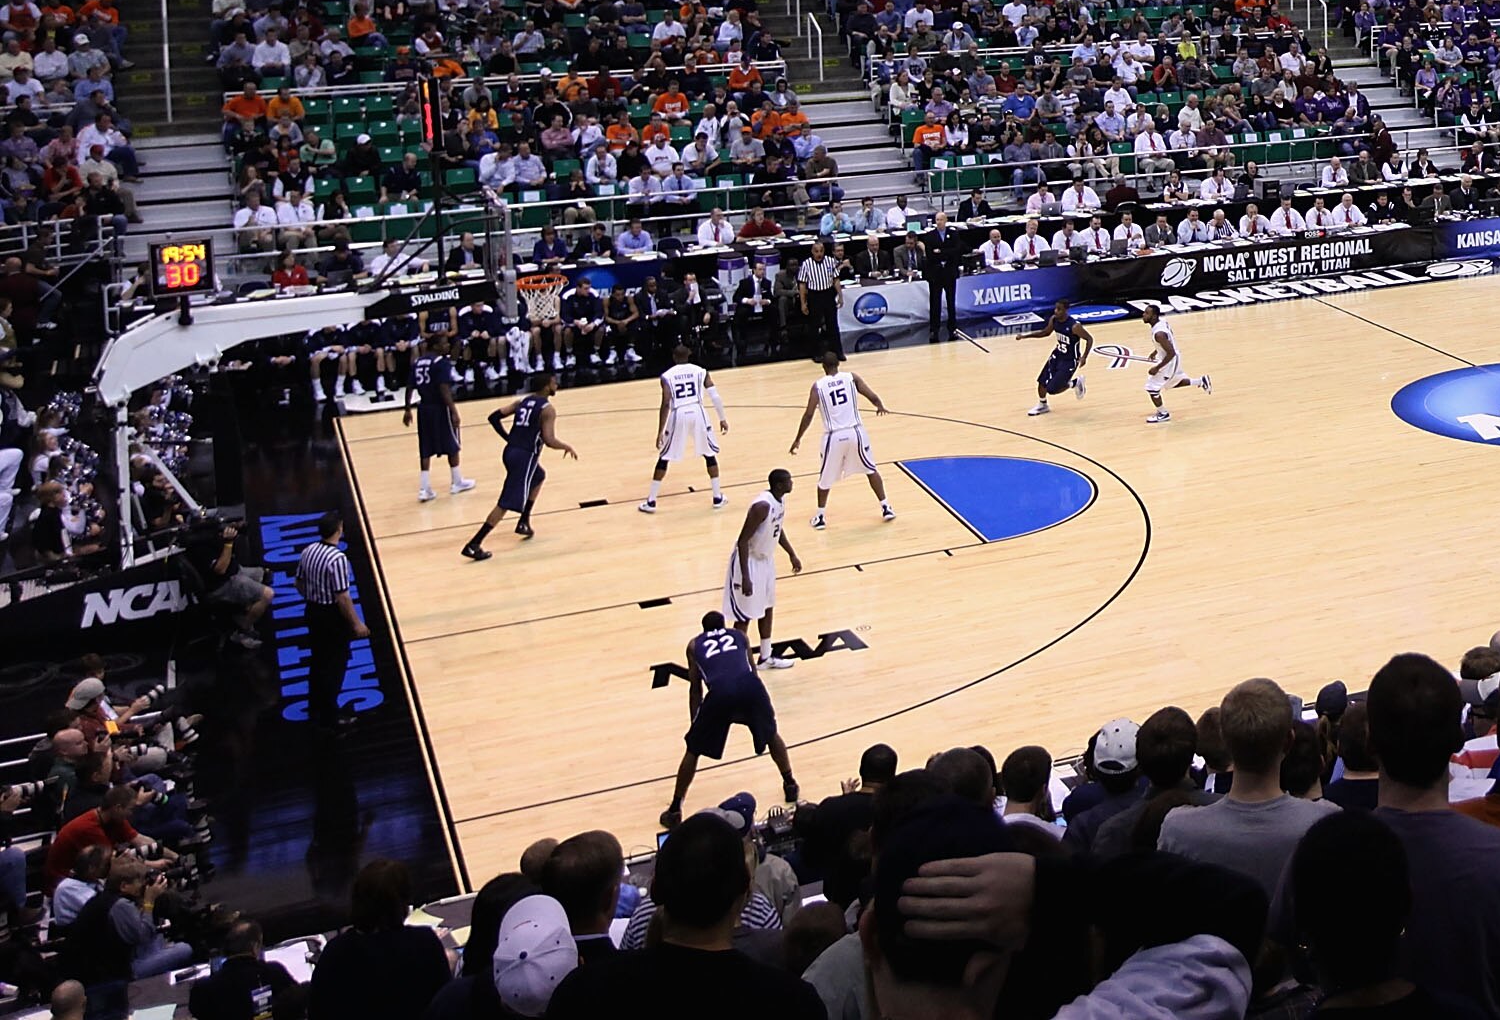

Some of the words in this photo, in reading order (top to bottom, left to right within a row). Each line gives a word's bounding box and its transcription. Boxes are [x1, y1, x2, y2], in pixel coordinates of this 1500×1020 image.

[1254, 247, 1297, 265] WEST
[1300, 238, 1372, 261] REGIONAL
[166, 263, 200, 288] 30
[1227, 268, 1256, 282] SALT
[1259, 265, 1287, 279] LAKE
[1290, 261, 1318, 275] CITY,
[1322, 257, 1350, 271] UTAH
[411, 288, 460, 306] SPALDING
[973, 283, 1032, 306] XAVIER
[1127, 268, 1429, 314] BASKETBALL
[857, 306, 887, 318] NCAA
[415, 367, 430, 384] 55
[675, 381, 696, 399] 23
[829, 388, 848, 406] 15
[516, 408, 533, 426] 31
[703, 635, 738, 658] 22
